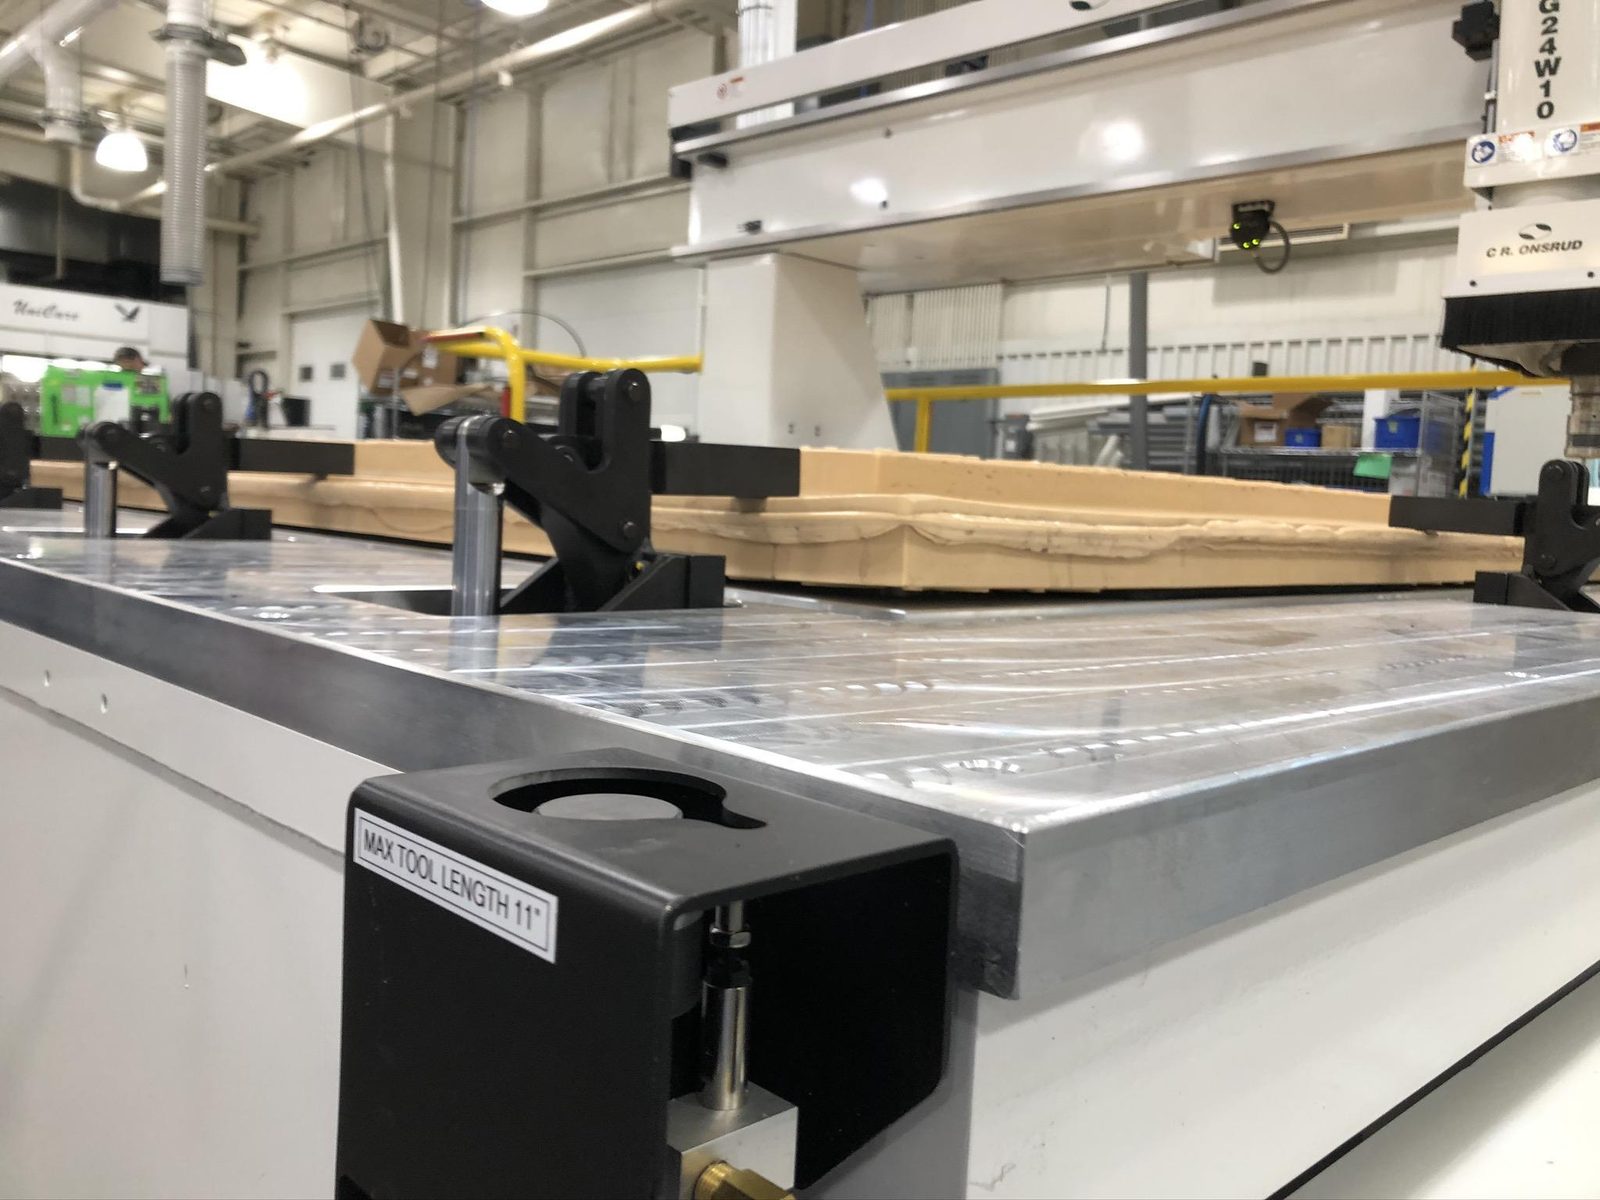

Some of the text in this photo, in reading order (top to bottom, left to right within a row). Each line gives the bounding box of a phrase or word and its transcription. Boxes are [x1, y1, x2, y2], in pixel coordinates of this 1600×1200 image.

[1519, 240, 1583, 255] ONSRUD
[364, 829, 394, 864] MAX
[397, 844, 437, 884] TOOL
[442, 865, 509, 919] LENGTH
